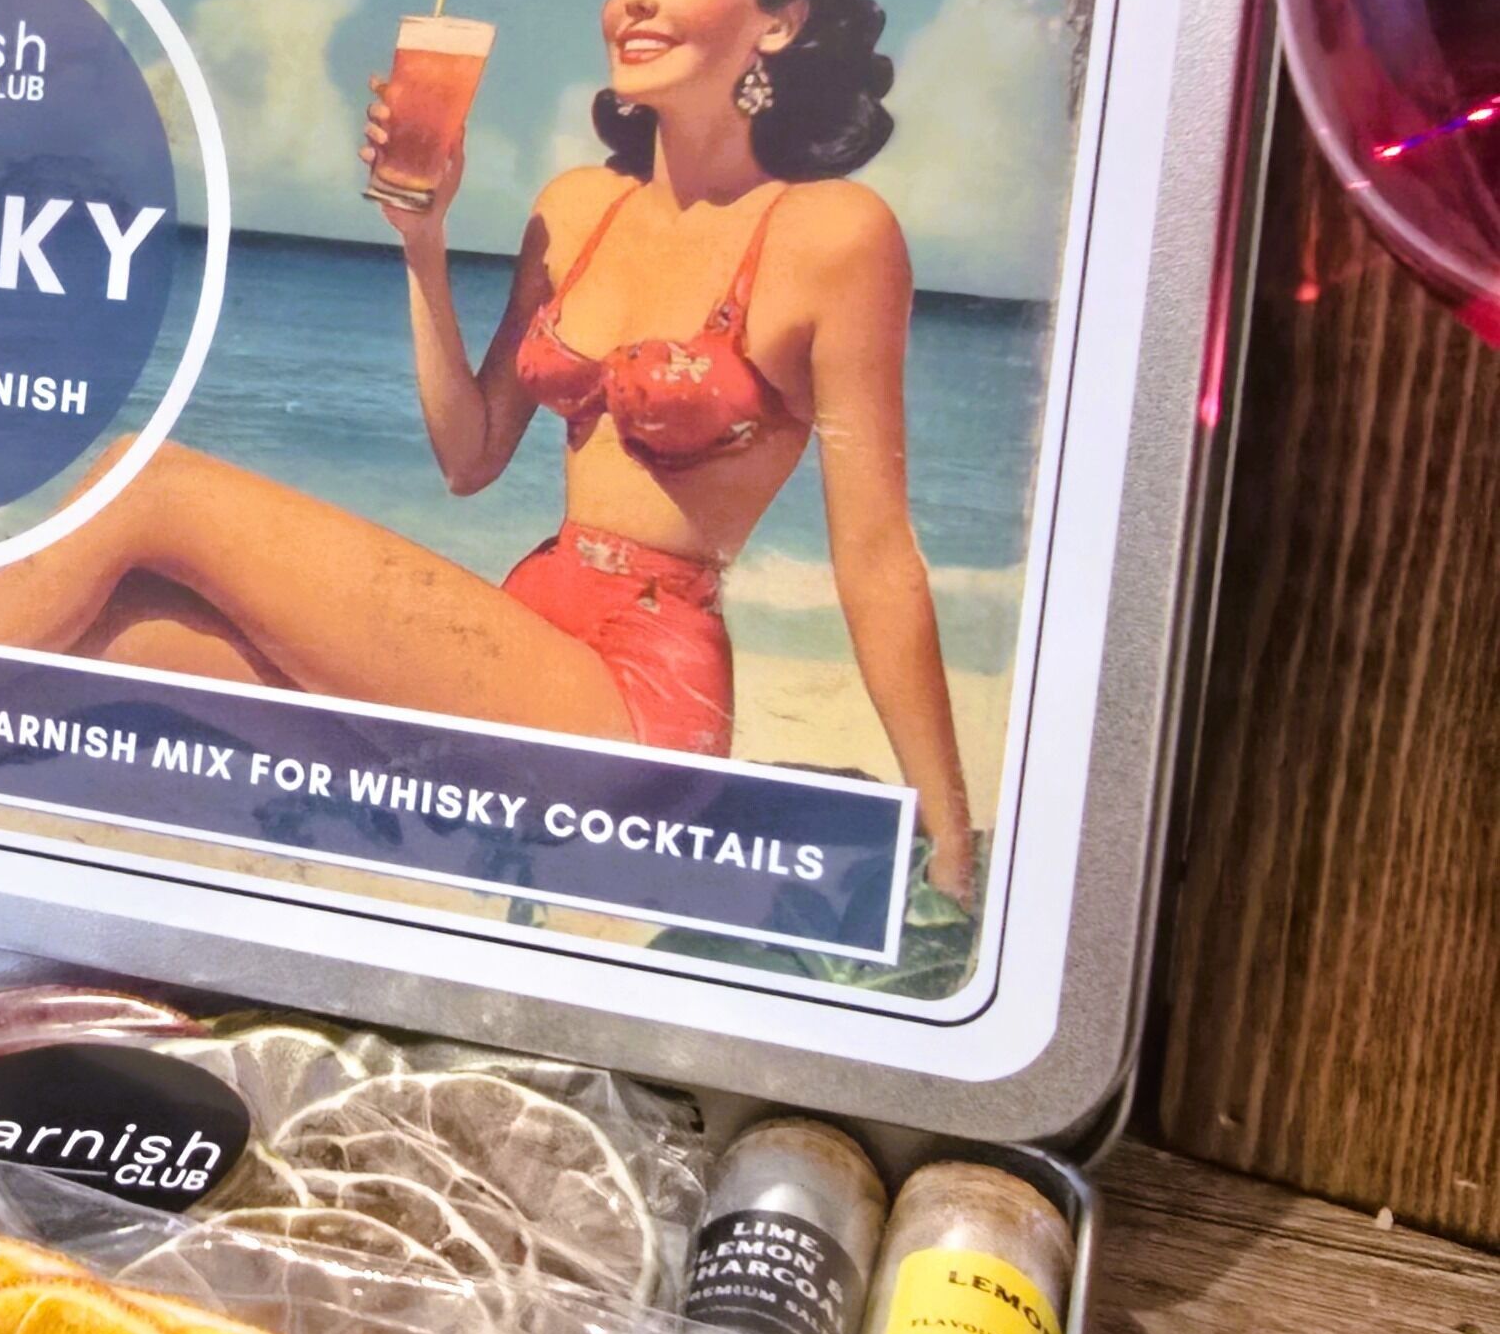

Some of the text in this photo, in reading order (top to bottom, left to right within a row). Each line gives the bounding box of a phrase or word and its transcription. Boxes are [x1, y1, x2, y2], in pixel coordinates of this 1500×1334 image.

[152, 736, 233, 780] MIX
[249, 754, 331, 798] FOR
[349, 768, 527, 829] WHISKY
[544, 803, 825, 880] COCKTAILS
[114, 1163, 209, 1191] CLUB
[698, 1241, 816, 1275] LEMON
[689, 1284, 777, 1303] REMIUM
